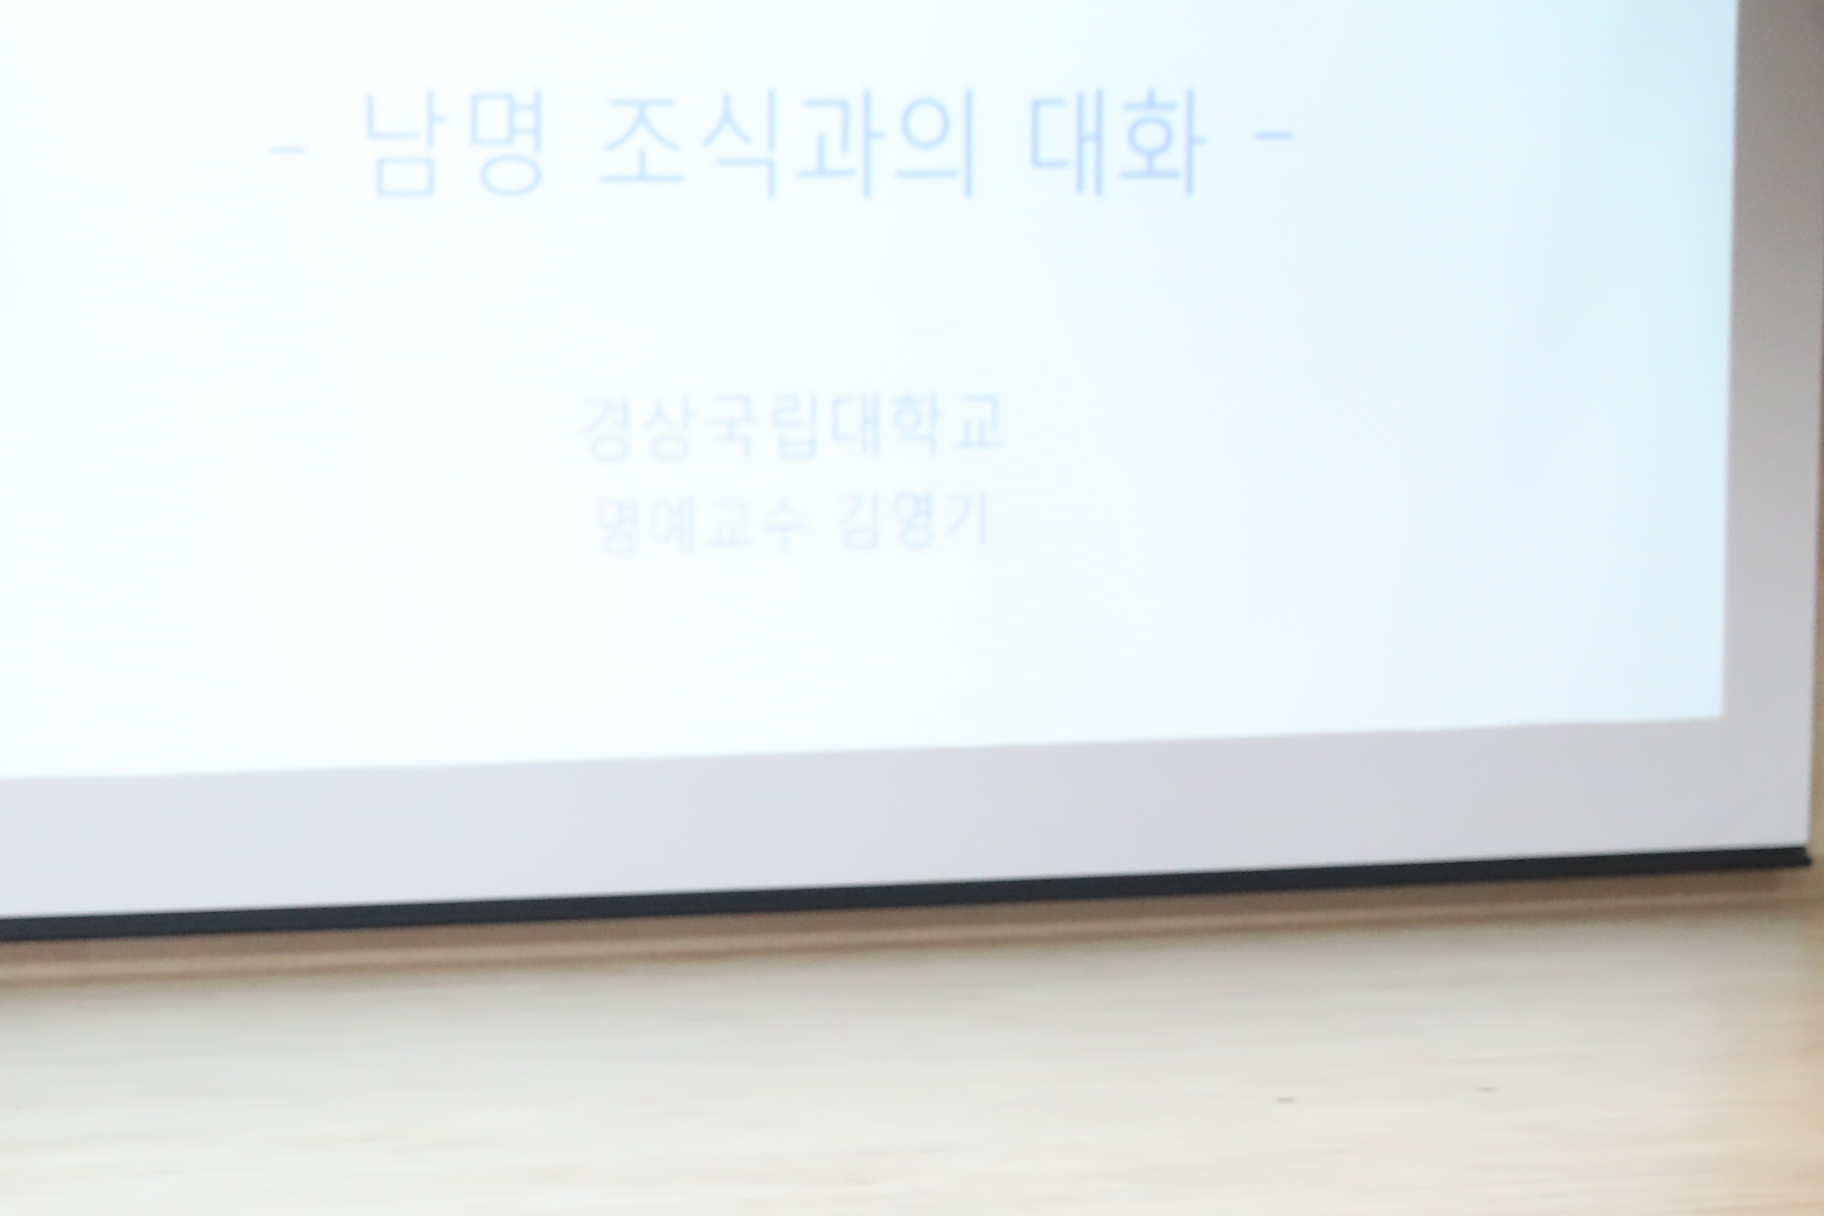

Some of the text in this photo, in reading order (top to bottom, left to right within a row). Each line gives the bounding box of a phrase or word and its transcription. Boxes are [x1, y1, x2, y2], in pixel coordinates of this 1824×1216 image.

[364, 89, 548, 198] 남명
[598, 87, 974, 198] 조식과의
[1029, 87, 1208, 198] 대화
[582, 390, 1004, 463] 경상국립대학교
[596, 490, 990, 556] 명예교수 김영기
